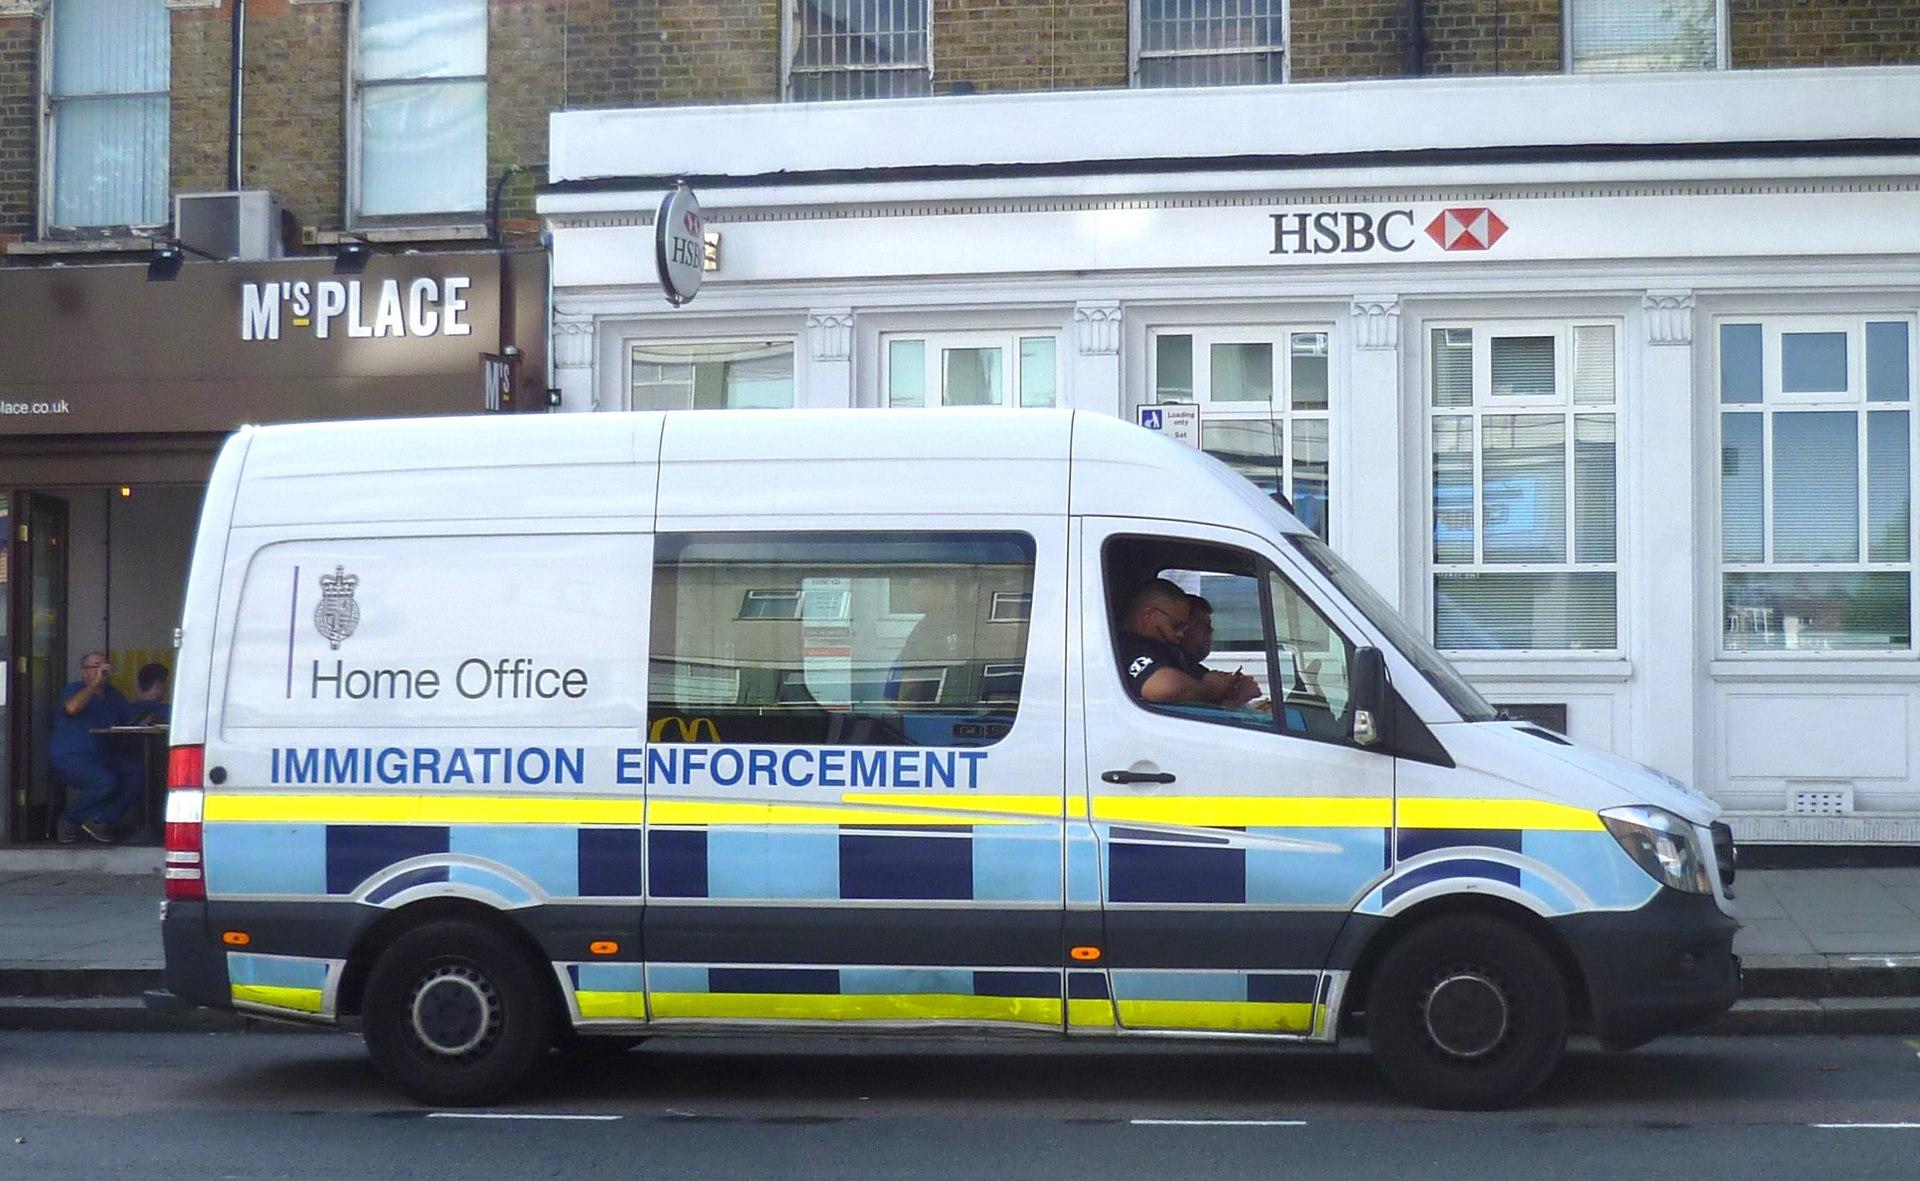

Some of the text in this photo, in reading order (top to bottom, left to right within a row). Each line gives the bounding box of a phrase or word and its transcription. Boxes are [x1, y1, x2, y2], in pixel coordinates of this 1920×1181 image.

[1269, 209, 1415, 255] HSBC
[316, 277, 471, 339] PLACE
[0, 399, 69, 414] lace.co.uk
[311, 658, 588, 699] Home Office
[271, 747, 988, 788] IMMIGRATION ENFORCEMENT
